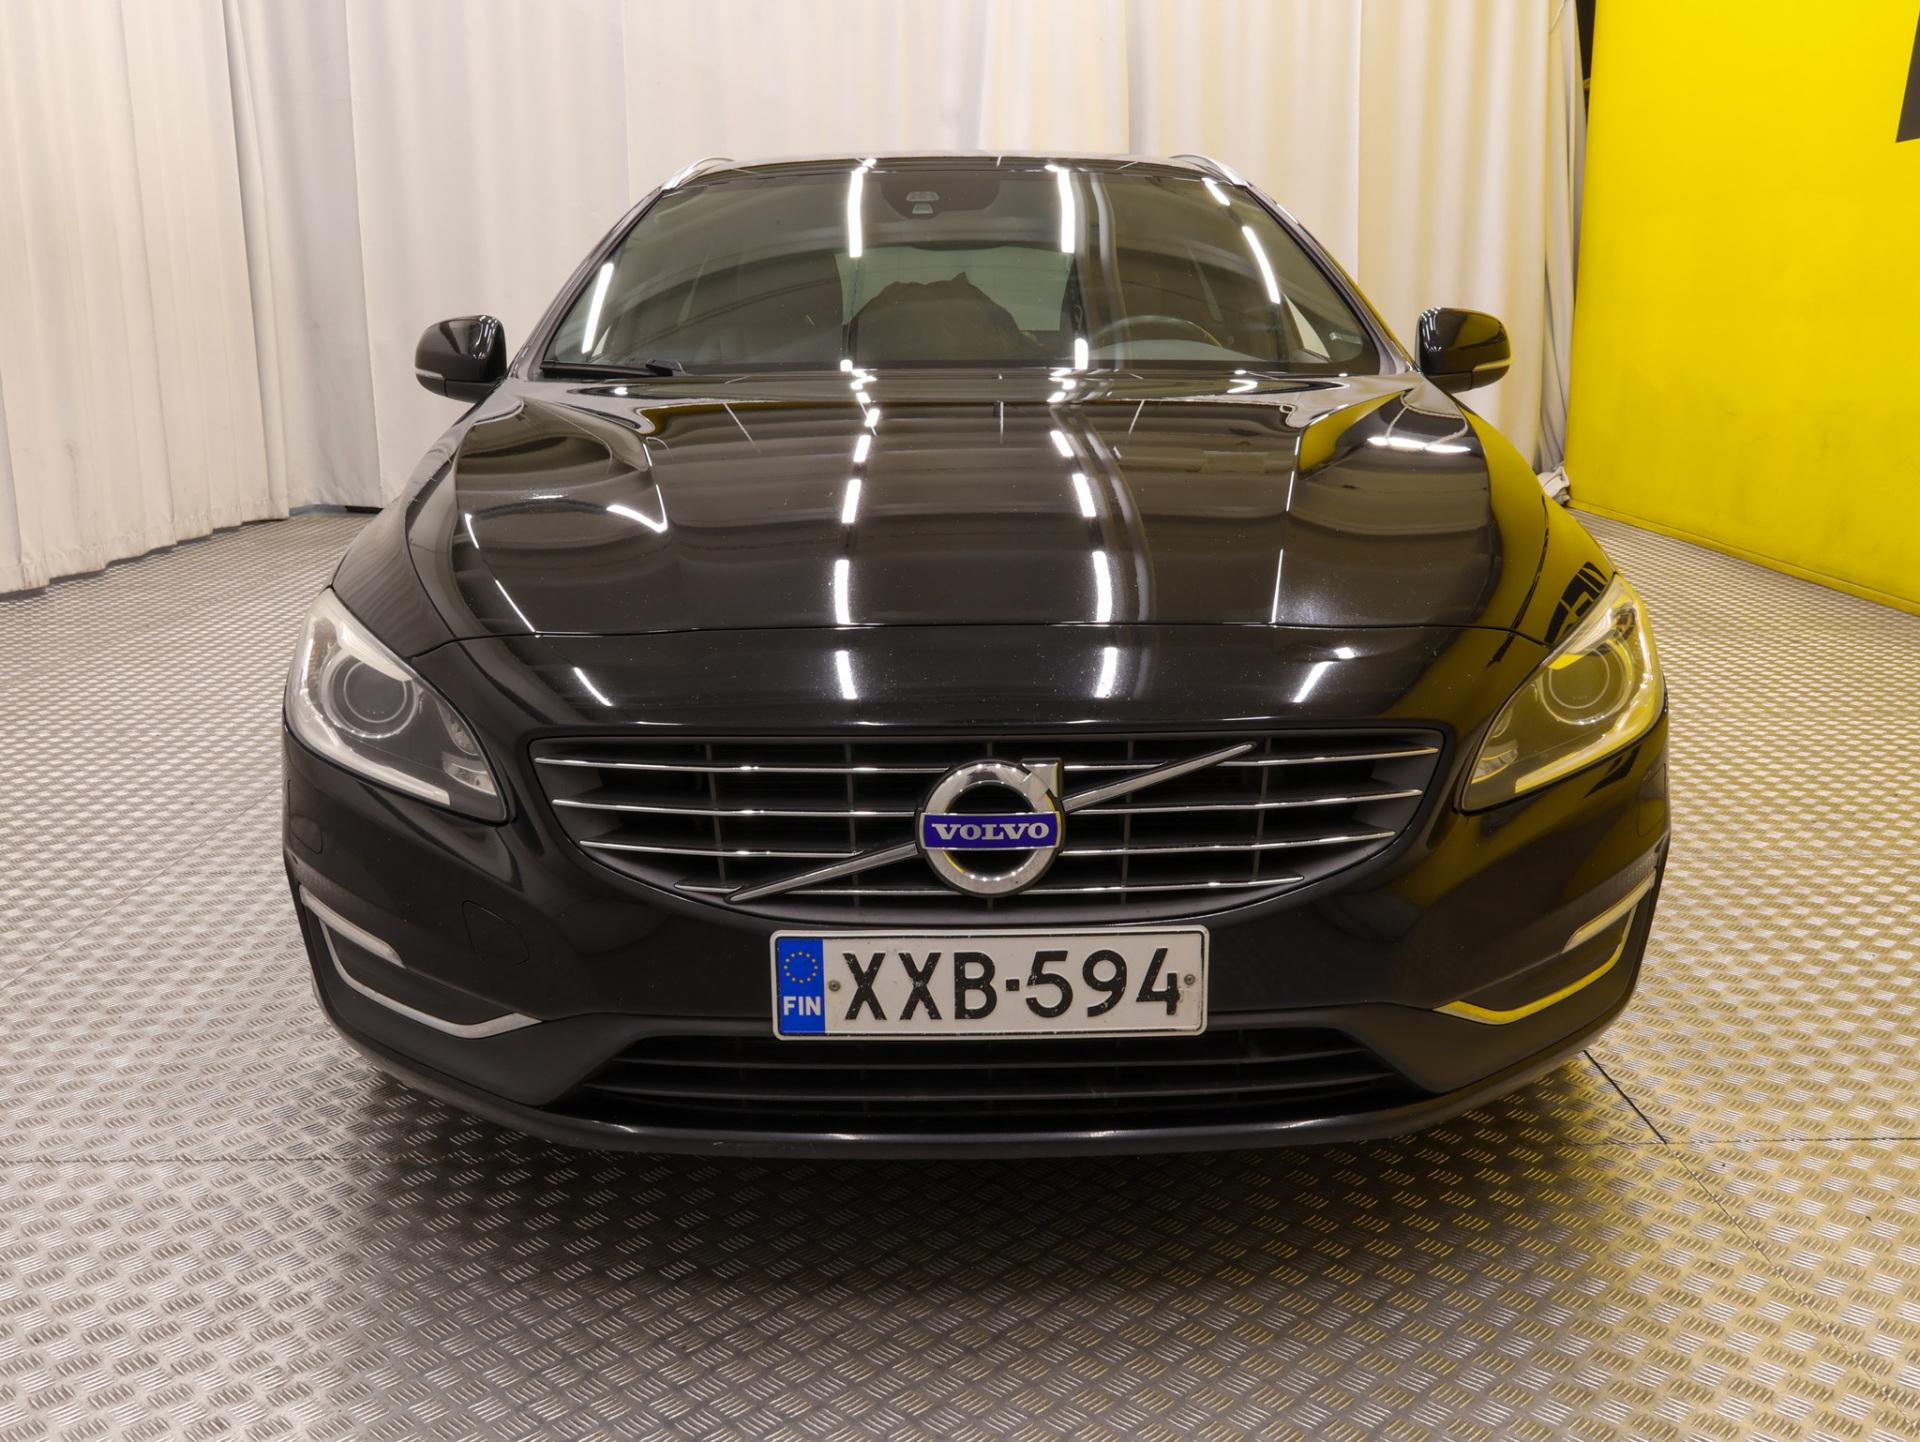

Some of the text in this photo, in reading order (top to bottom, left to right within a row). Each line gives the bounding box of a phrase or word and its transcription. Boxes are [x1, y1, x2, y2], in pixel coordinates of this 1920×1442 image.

[931, 822, 1050, 841] VOLVO
[842, 947, 1180, 1021] XXB-594
[783, 995, 822, 1017] FIN
